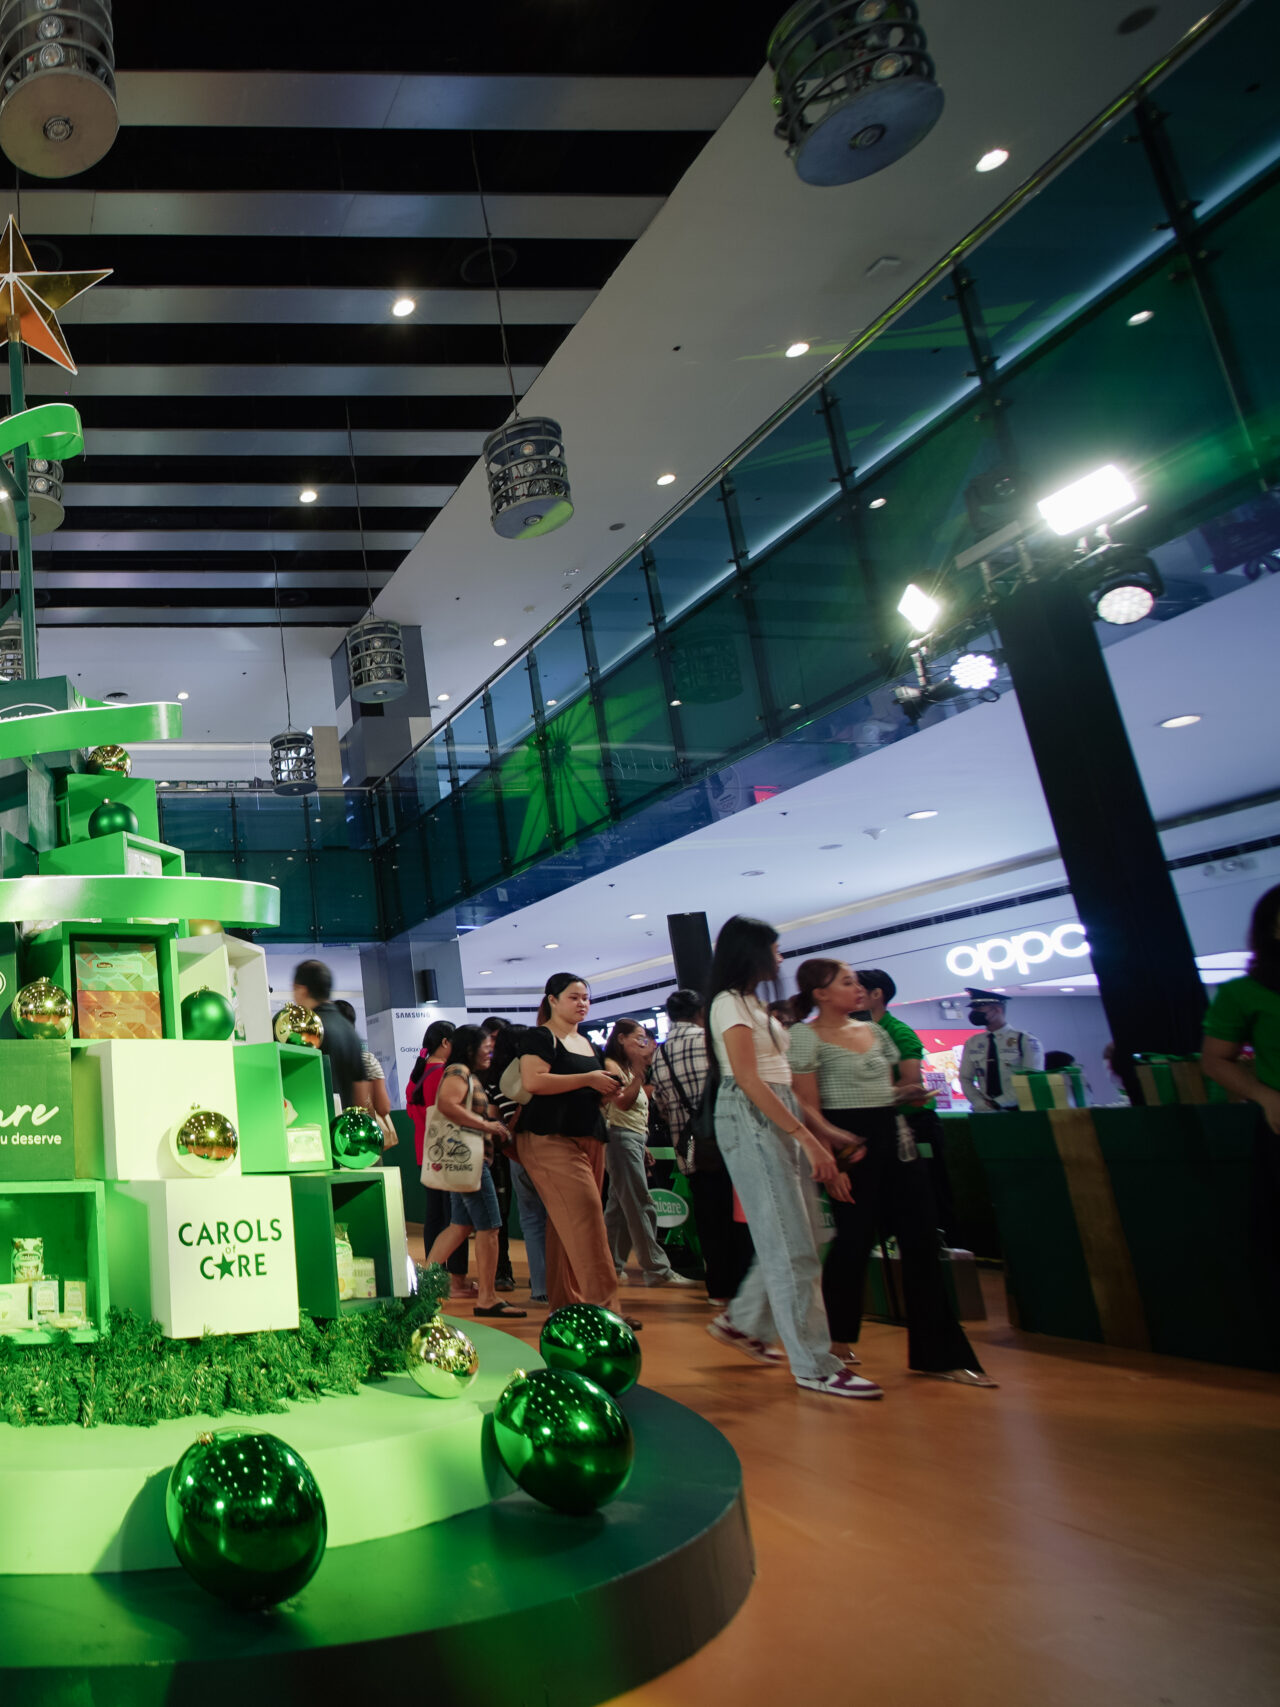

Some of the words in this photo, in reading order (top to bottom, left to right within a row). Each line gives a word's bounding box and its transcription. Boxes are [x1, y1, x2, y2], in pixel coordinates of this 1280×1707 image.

[11, 1132, 62, 1145] deserve
[653, 1196, 682, 1214] nicare
[178, 1218, 282, 1246] CAROLS
[225, 1245, 236, 1254] of
